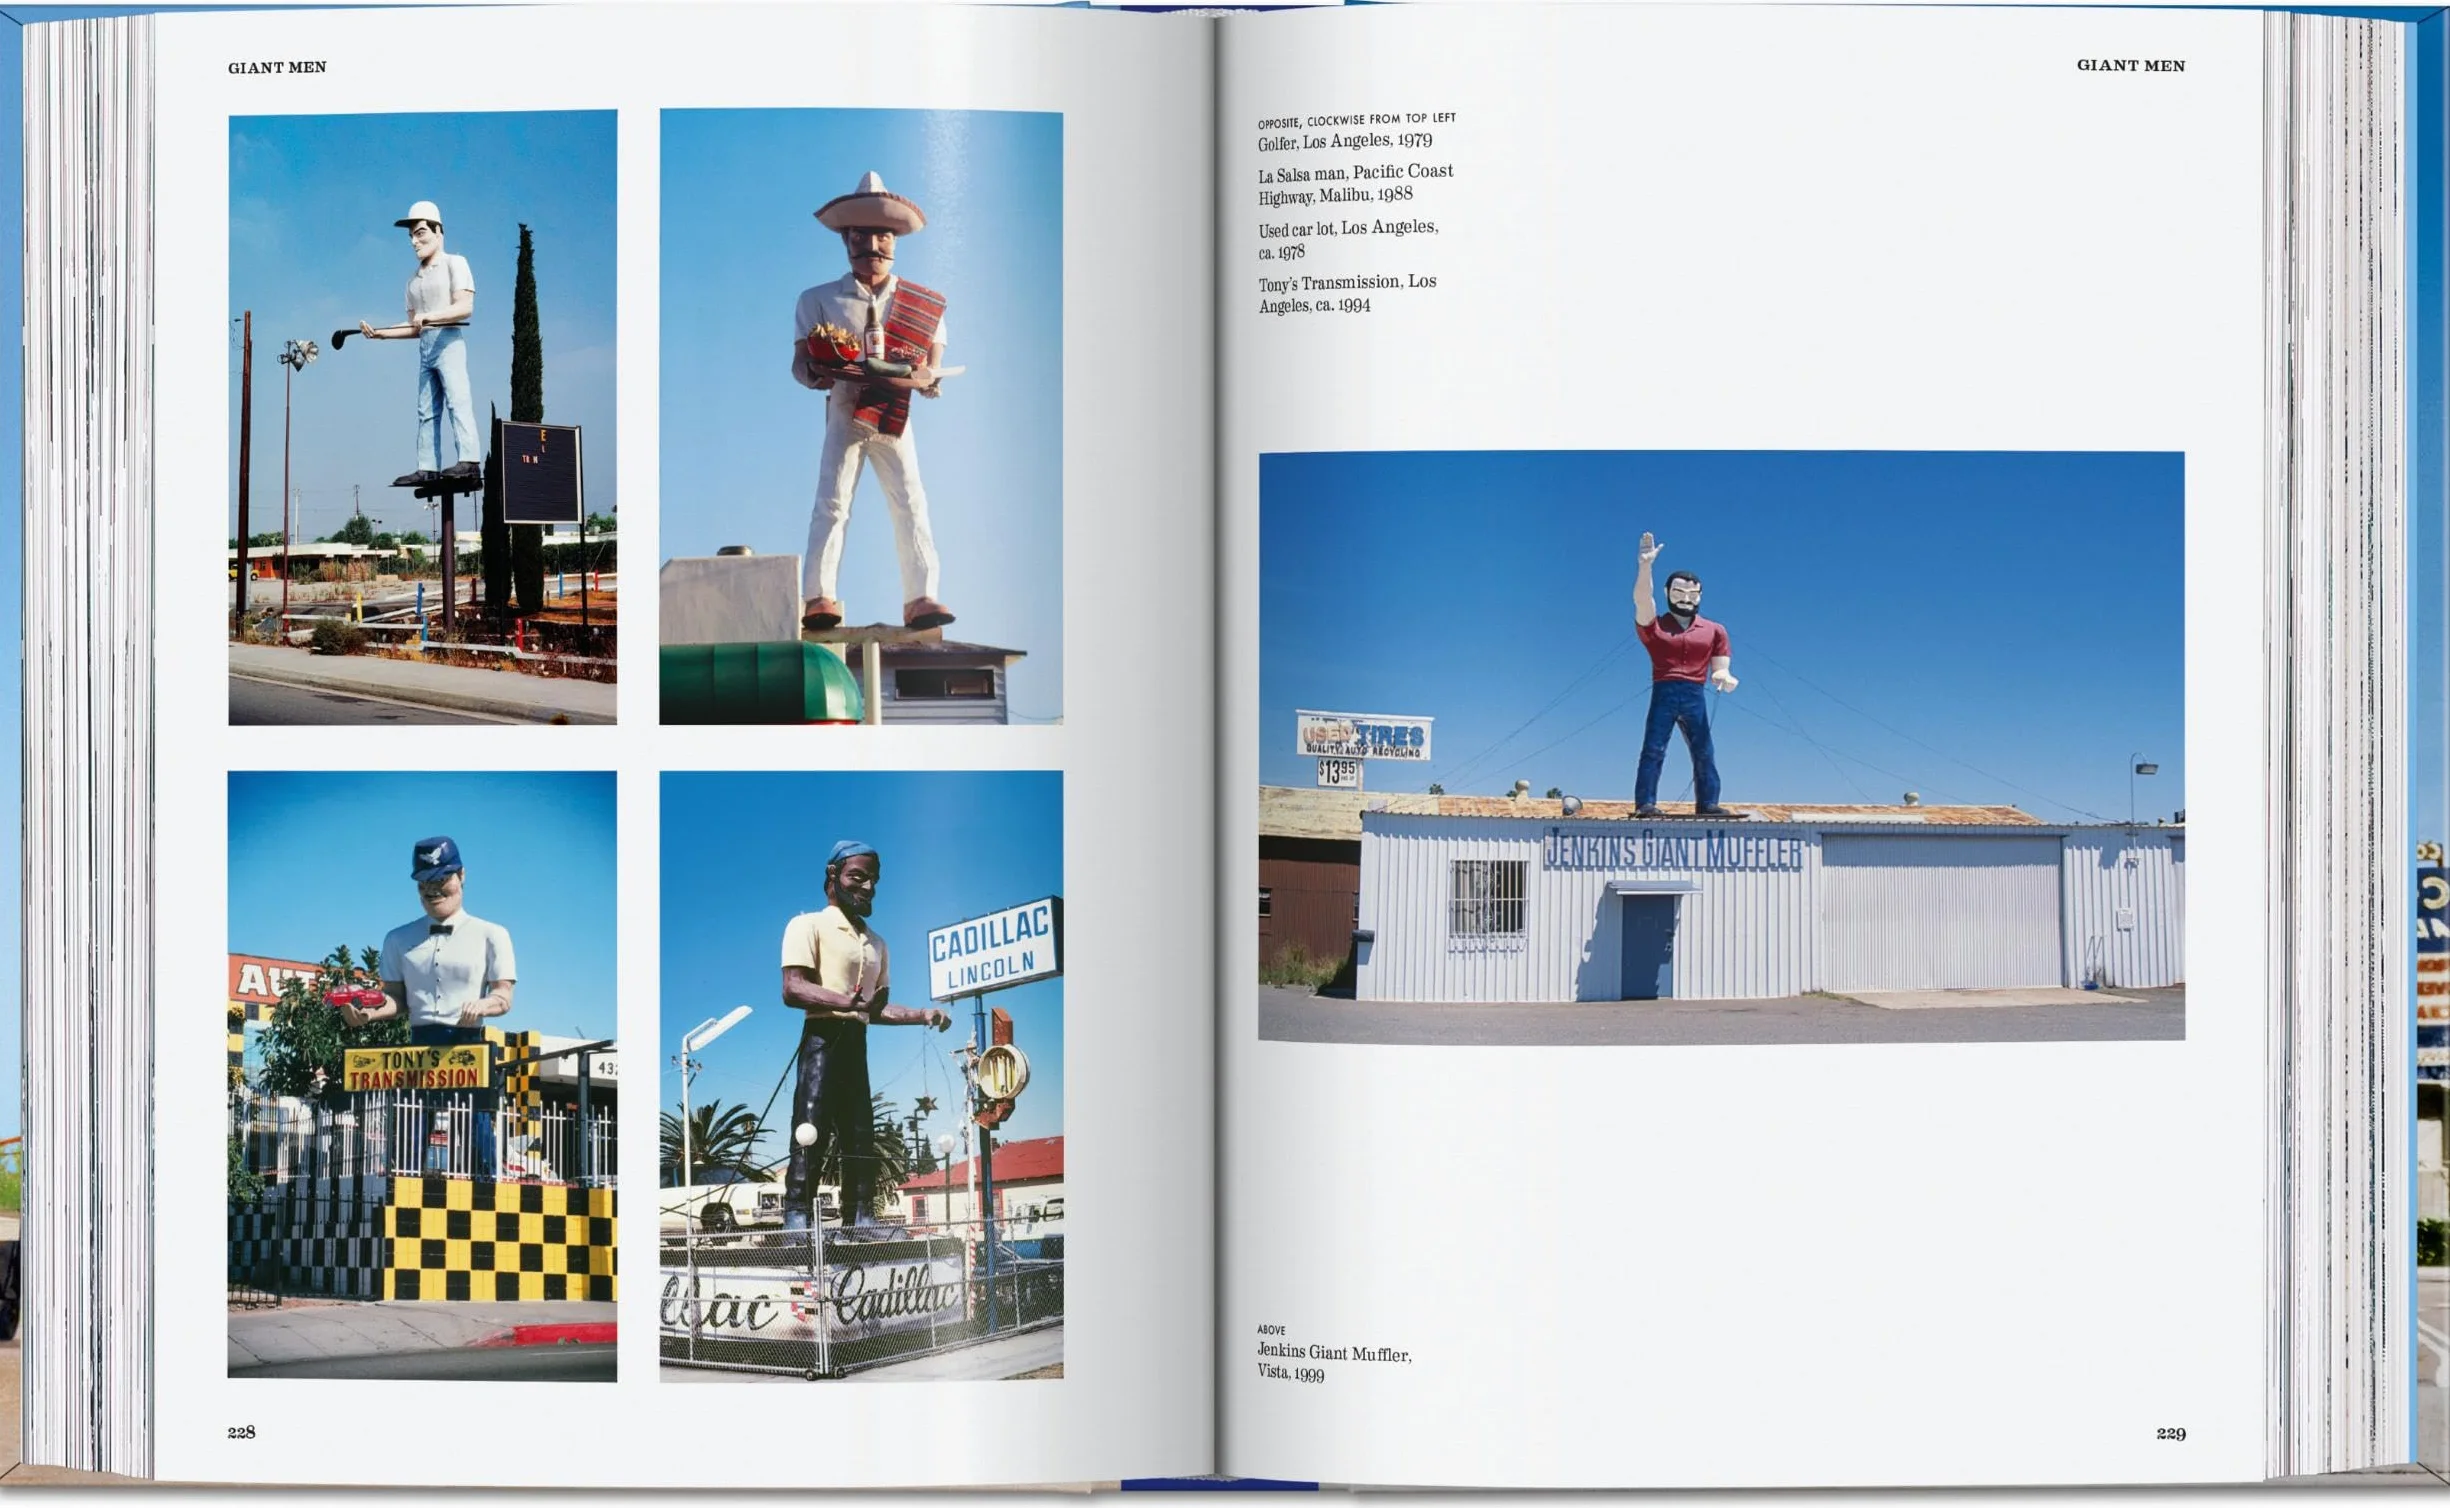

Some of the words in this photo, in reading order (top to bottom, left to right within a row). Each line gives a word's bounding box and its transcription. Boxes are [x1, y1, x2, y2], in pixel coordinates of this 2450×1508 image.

[228, 62, 284, 74] GIANT
[288, 61, 327, 73] MEN
[2077, 59, 2139, 71] GIANT
[2144, 60, 2186, 72] MEN
[1258, 117, 1303, 130] OPPOSITE,
[1307, 115, 1365, 127] CLOCKWISE
[1370, 113, 1400, 125] FROM
[1406, 113, 1428, 124] TOP
[1433, 112, 1456, 123] LEFT
[1258, 135, 1300, 152] Golfer,
[1303, 134, 1327, 150] Los
[1331, 132, 1394, 151] Angeles,
[1398, 132, 1433, 148] 1979
[1259, 169, 1274, 184] La
[1277, 168, 1310, 183] Salsa
[1314, 169, 1349, 181] man,
[1353, 164, 1404, 179] Pacific
[1408, 163, 1455, 179] Coast
[1259, 189, 1316, 208] Highway,
[1320, 187, 1374, 203] Malibu,
[1377, 185, 1413, 203] 1988
[1259, 223, 1289, 239] Used
[1292, 226, 1313, 237] car
[1317, 221, 1338, 237] lot,
[1341, 220, 1367, 235] Los
[1371, 219, 1439, 237] Angeles,
[1259, 248, 1275, 260] ca.
[1278, 243, 1305, 261] 1978
[1302, 274, 1404, 291] Transmission,
[1408, 273, 1437, 288] Los
[1259, 298, 1313, 317] Angeles,
[1316, 299, 1335, 312] ca.
[1338, 298, 1371, 313] 1994
[1303, 725, 1352, 744] USED
[1356, 722, 1425, 747] TIRES
[1547, 827, 1636, 867] JENKINS
[1642, 828, 1703, 868] GIANT
[1706, 829, 1803, 870] MUFFLER
[932, 905, 1049, 963] CADILLAC
[948, 950, 1034, 989] LINCOLN
[380, 1050, 441, 1070] TONY'S
[350, 1068, 479, 1090] TRANSMISSION
[831, 1260, 960, 1325] Cadillac
[1257, 1324, 1286, 1336] ABOVE
[1257, 1341, 1306, 1358] Jenkins
[1309, 1344, 1348, 1361] Giant
[1352, 1346, 1412, 1364] Muffler,
[1258, 1363, 1292, 1381] Vista,
[1294, 1366, 1325, 1384] 1999
[227, 1424, 256, 1439] 228
[2156, 1427, 2187, 1442] 229
